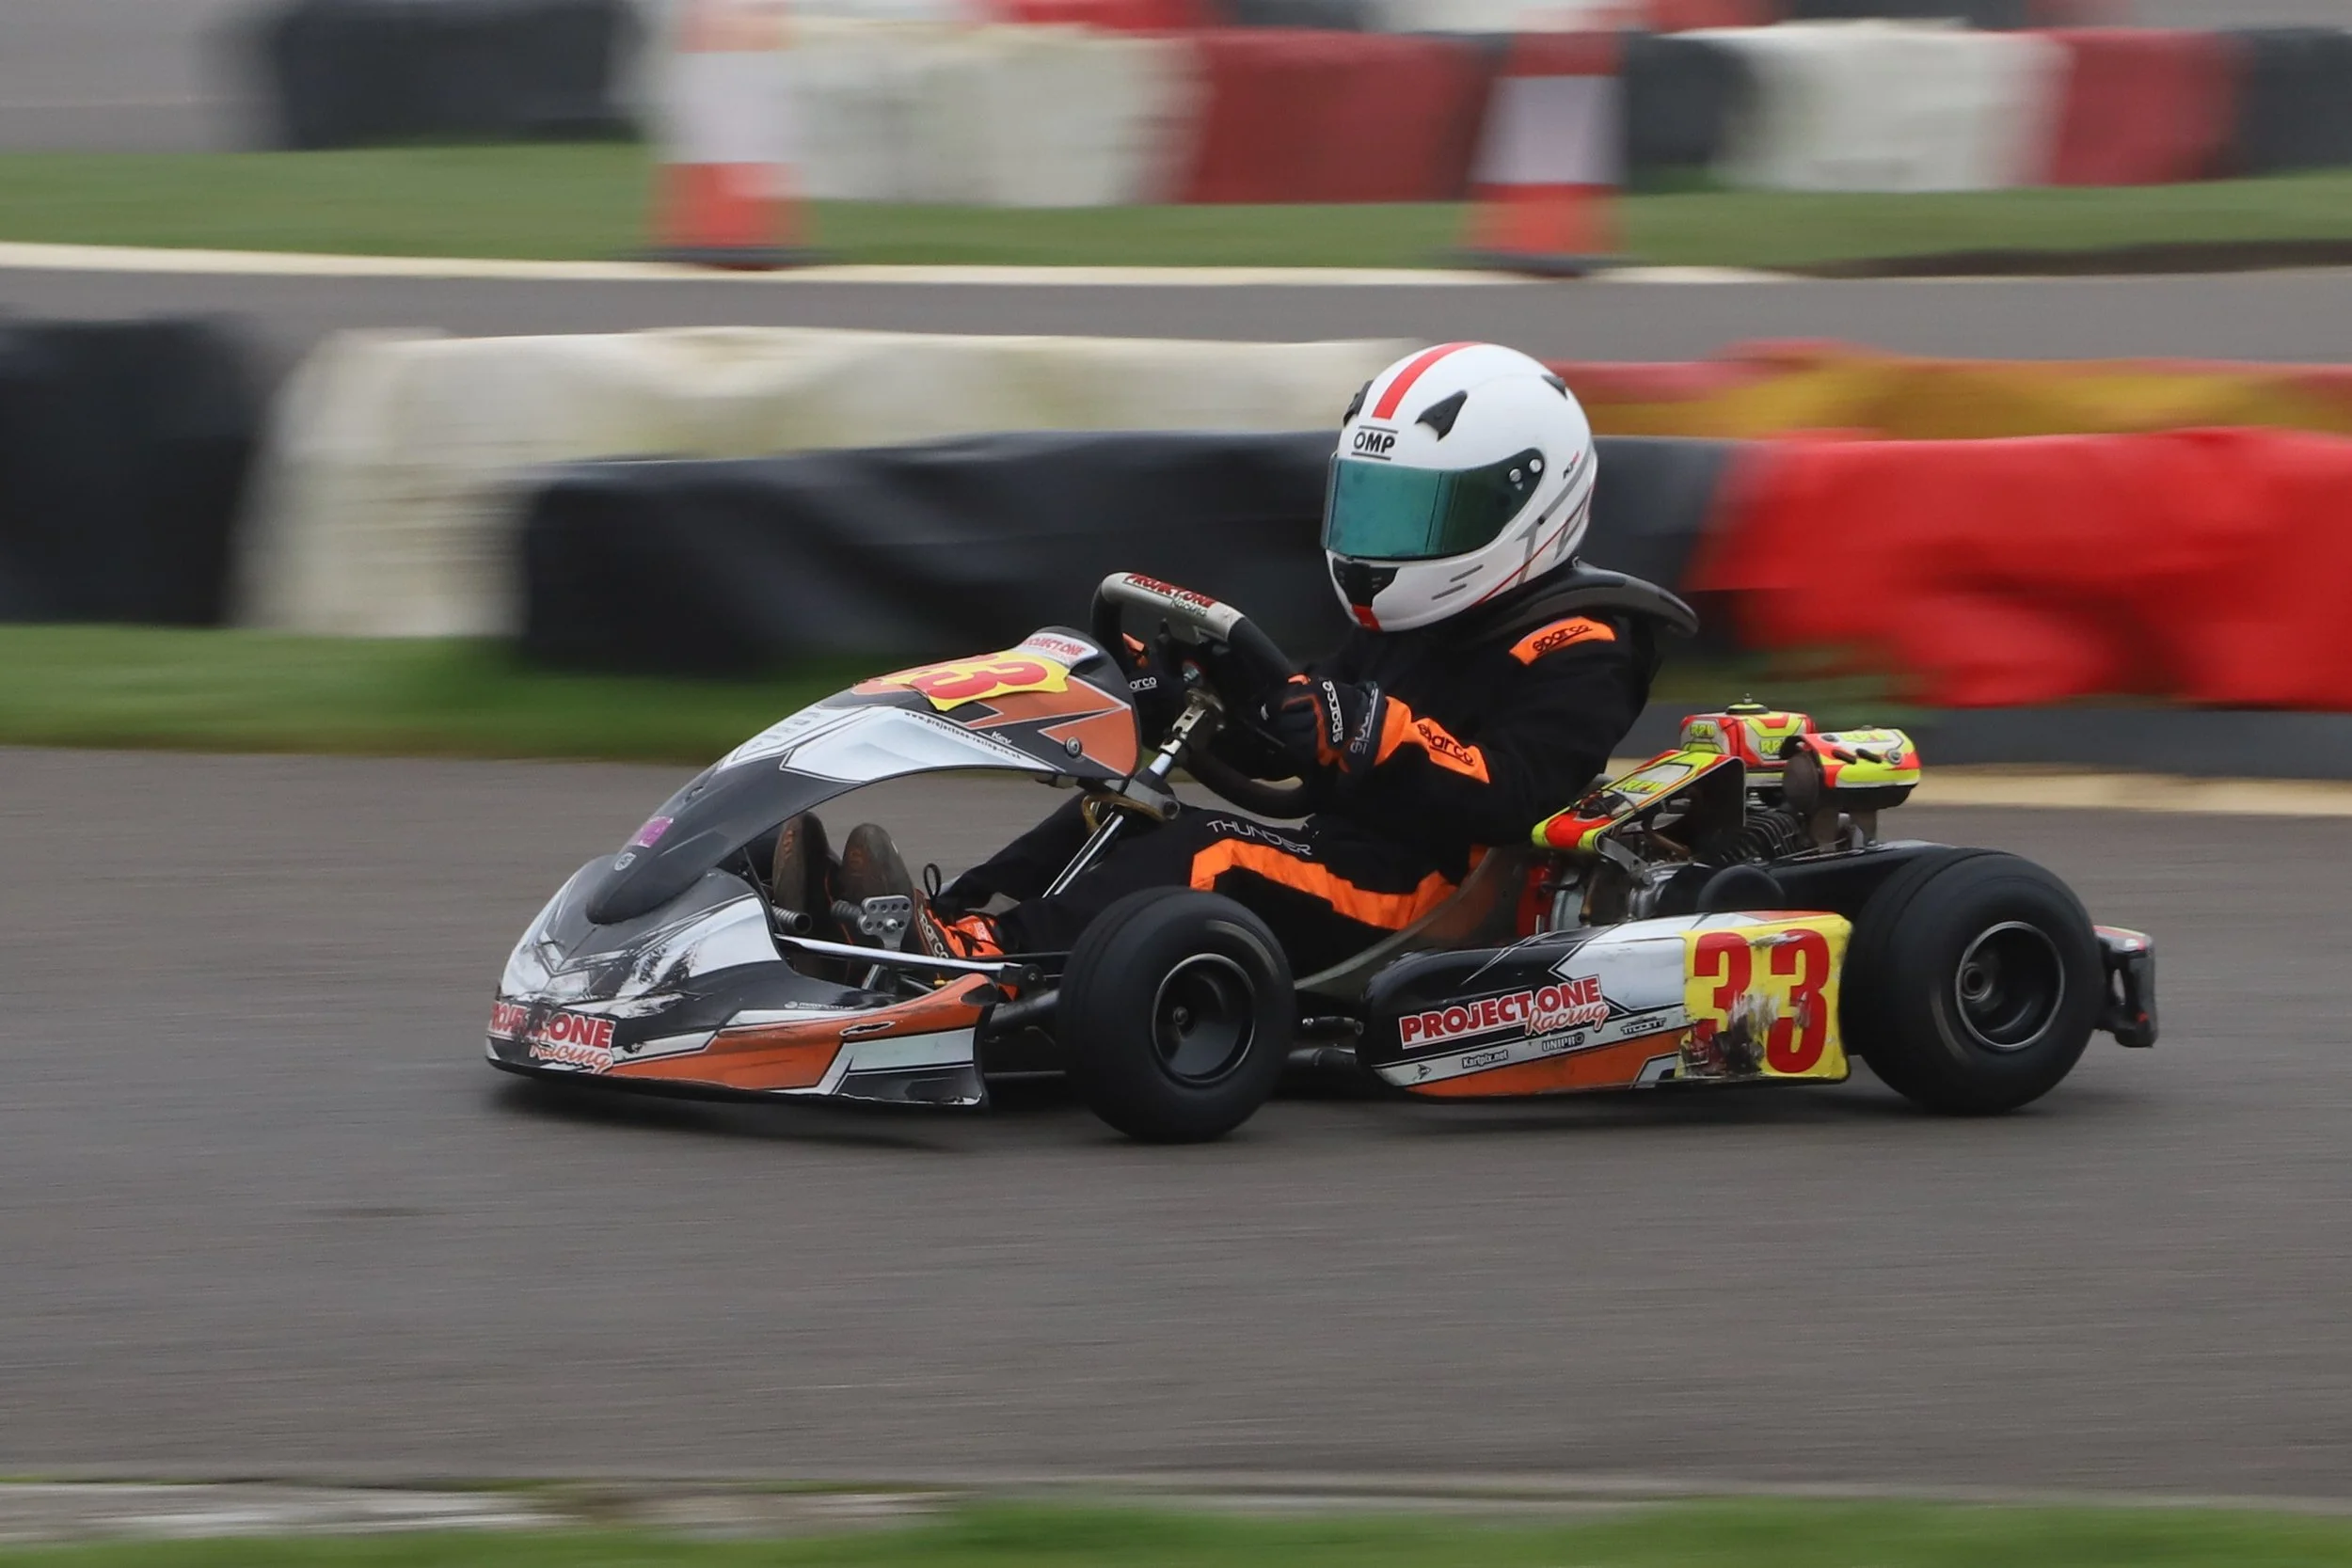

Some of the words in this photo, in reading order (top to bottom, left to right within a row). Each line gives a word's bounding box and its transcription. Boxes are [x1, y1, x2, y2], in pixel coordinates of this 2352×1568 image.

[1353, 432, 1395, 453] OMP
[1532, 625, 1593, 657] sparco
[1129, 676, 1158, 693] arco
[1322, 680, 1344, 743] sparco
[904, 712, 1022, 759] www.projectone-racing.co.uk
[1206, 819, 1312, 856] THUNDER
[1401, 992, 1533, 1042] PROJECT
[1536, 978, 1600, 1013] ONE
[1524, 1003, 1610, 1037] Racing
[548, 1012, 613, 1050] ONE
[1462, 1049, 1509, 1069] Kartpix.net
